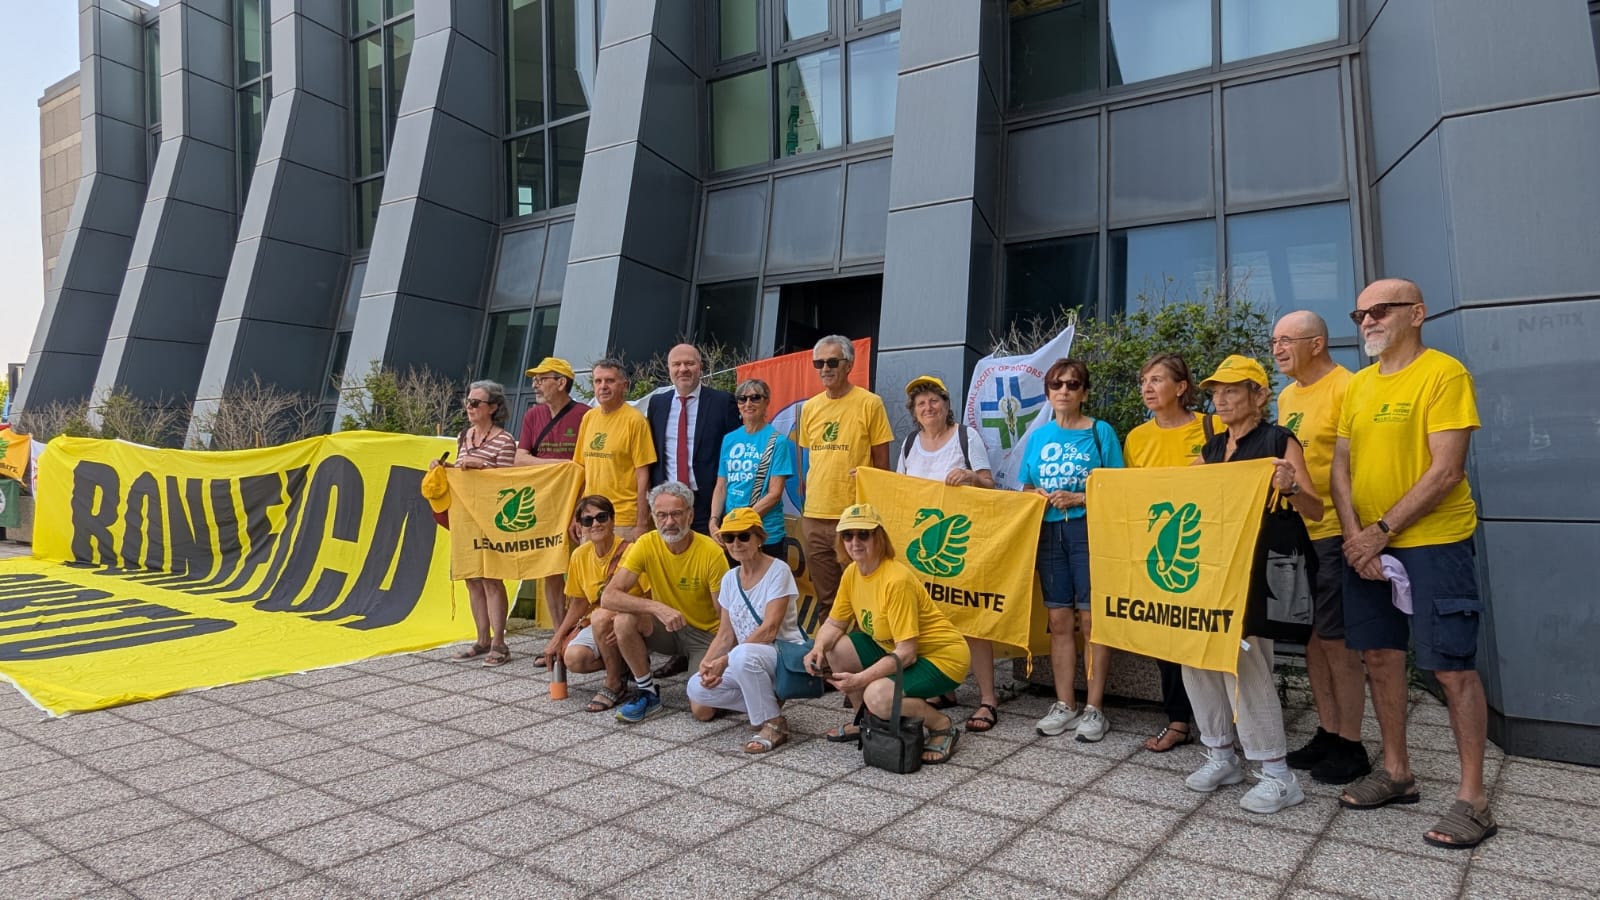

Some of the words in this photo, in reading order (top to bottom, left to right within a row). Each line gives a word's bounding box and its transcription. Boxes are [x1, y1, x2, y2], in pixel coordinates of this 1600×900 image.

[1062, 453, 1091, 461] PFAS
[1038, 461, 1089, 477] 100%
[727, 472, 757, 482] HAPP
